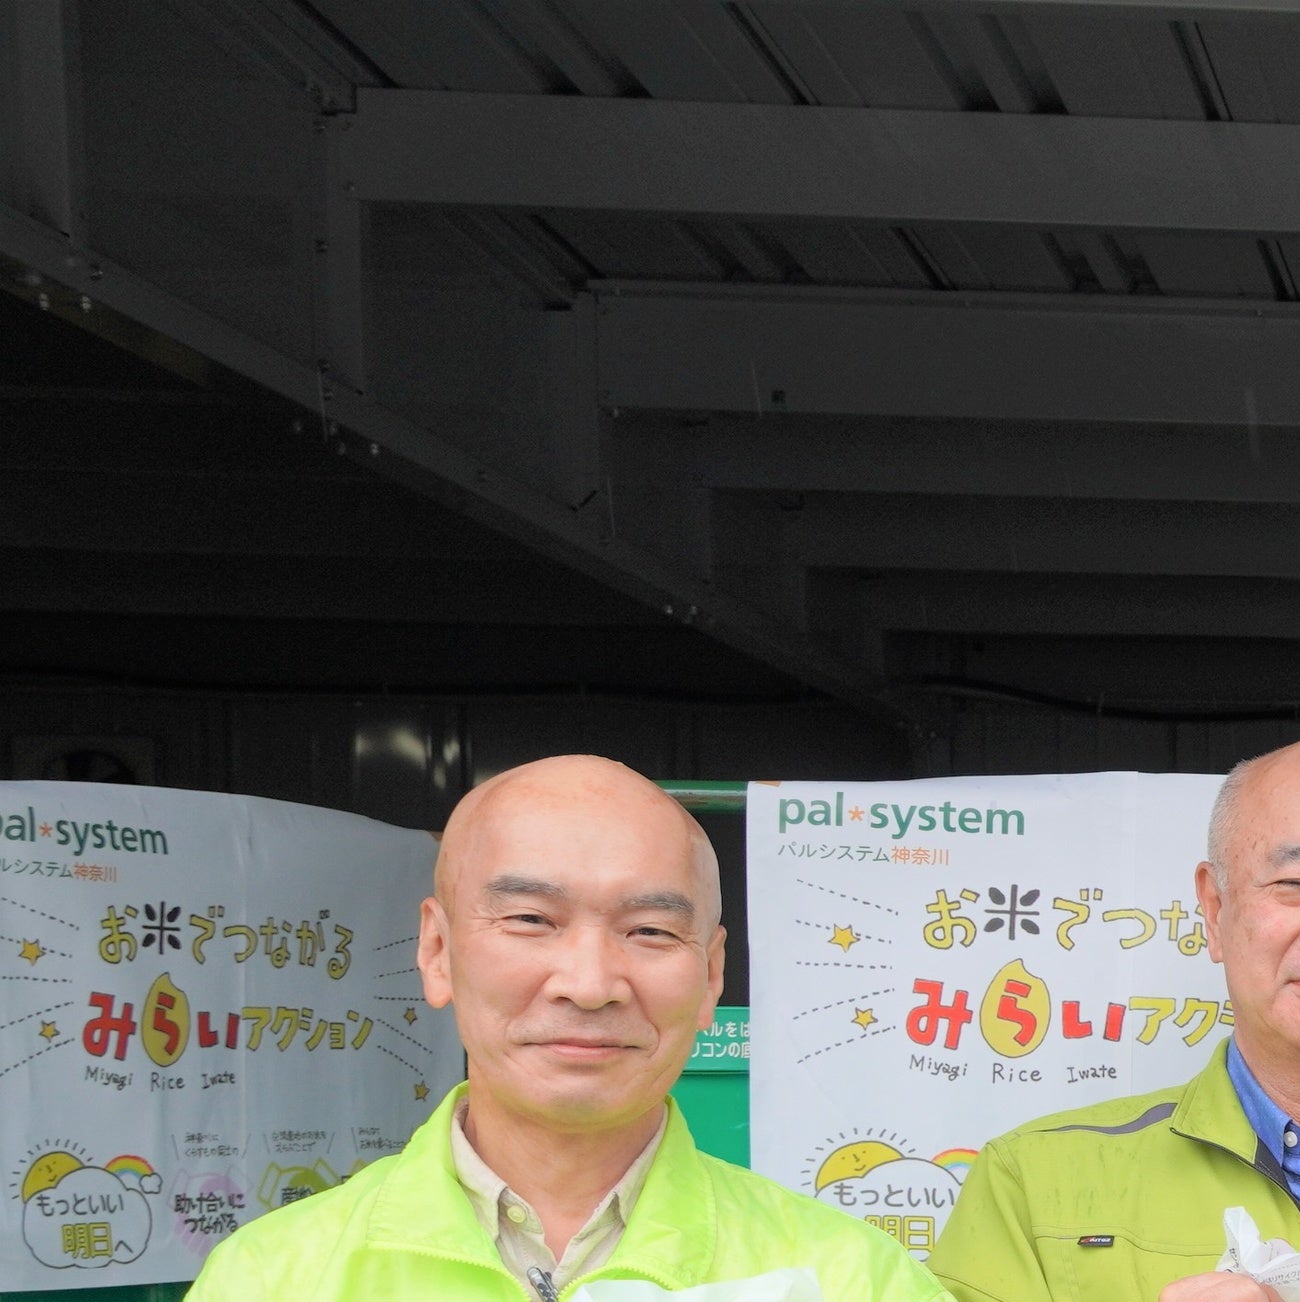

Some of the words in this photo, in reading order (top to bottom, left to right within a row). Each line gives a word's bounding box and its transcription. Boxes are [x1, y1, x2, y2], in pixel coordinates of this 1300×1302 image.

[0, 806, 36, 843] al
[56, 818, 169, 857] system
[778, 791, 844, 834] pal
[869, 799, 1026, 840] system
[777, 841, 950, 866] パルシステム神奈川
[922, 884, 1208, 957] お米でつな
[98, 900, 354, 980] お米でつながる
[81, 990, 374, 1062] みらいアクション
[84, 1065, 134, 1092] Miyagi
[150, 1071, 186, 1091] Rice
[909, 1054, 969, 1083] Miyagi
[991, 1063, 1043, 1084] Rice
[1066, 1064, 1118, 1084] Iwate
[36, 1192, 125, 1218] もっといい
[832, 1182, 955, 1209] もっといい
[62, 1221, 134, 1259] 明日へ
